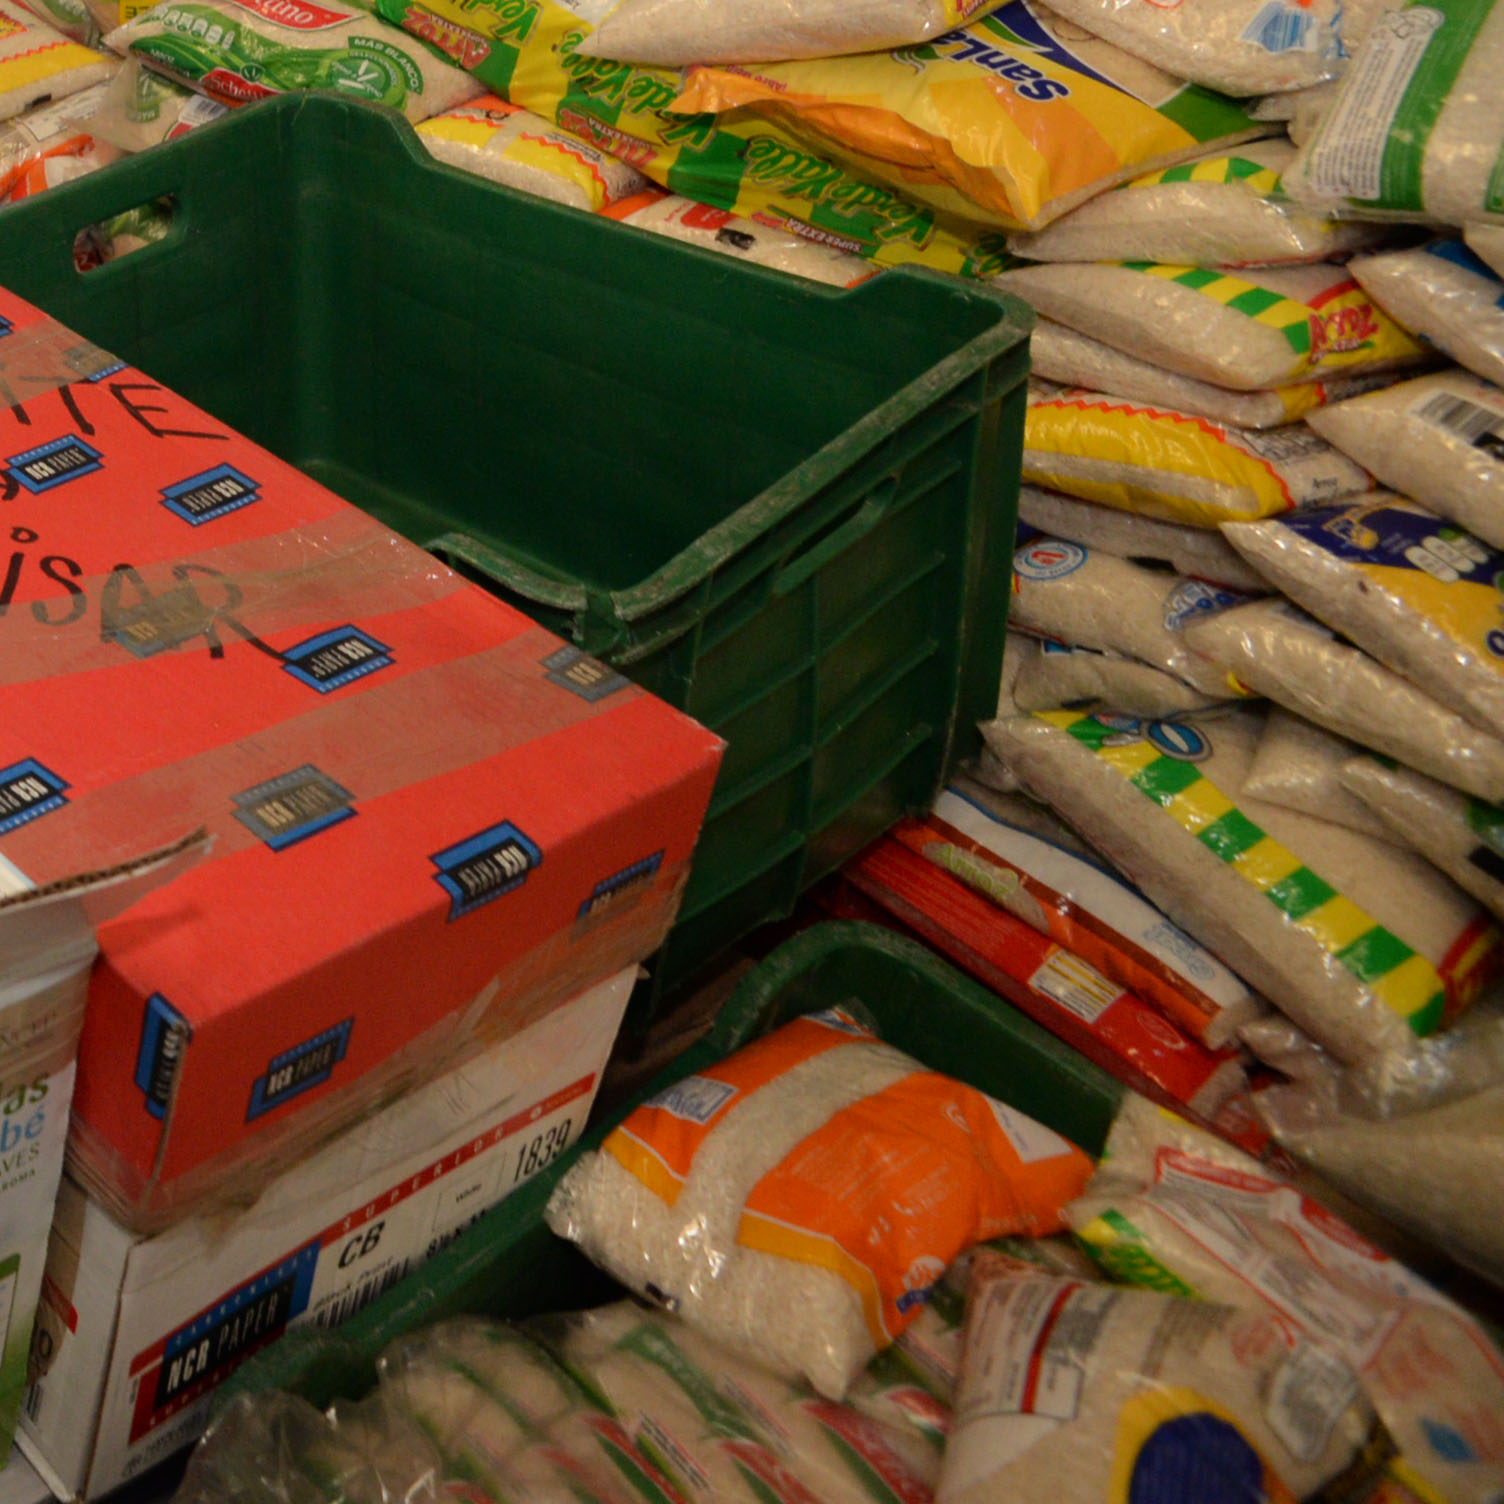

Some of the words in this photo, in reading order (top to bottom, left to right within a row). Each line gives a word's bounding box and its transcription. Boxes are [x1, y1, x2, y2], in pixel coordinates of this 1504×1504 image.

[24, 460, 52, 482] NCR
[50, 445, 91, 473] PAPER
[342, 638, 374, 663] NCR
[10, 776, 50, 802] NCR
[513, 1117, 573, 1183] 1839
[341, 1125, 505, 1232] SUPERIOR
[337, 1220, 386, 1270] CB
[166, 1337, 211, 1394] NCR
[214, 1291, 281, 1360] PAPER
